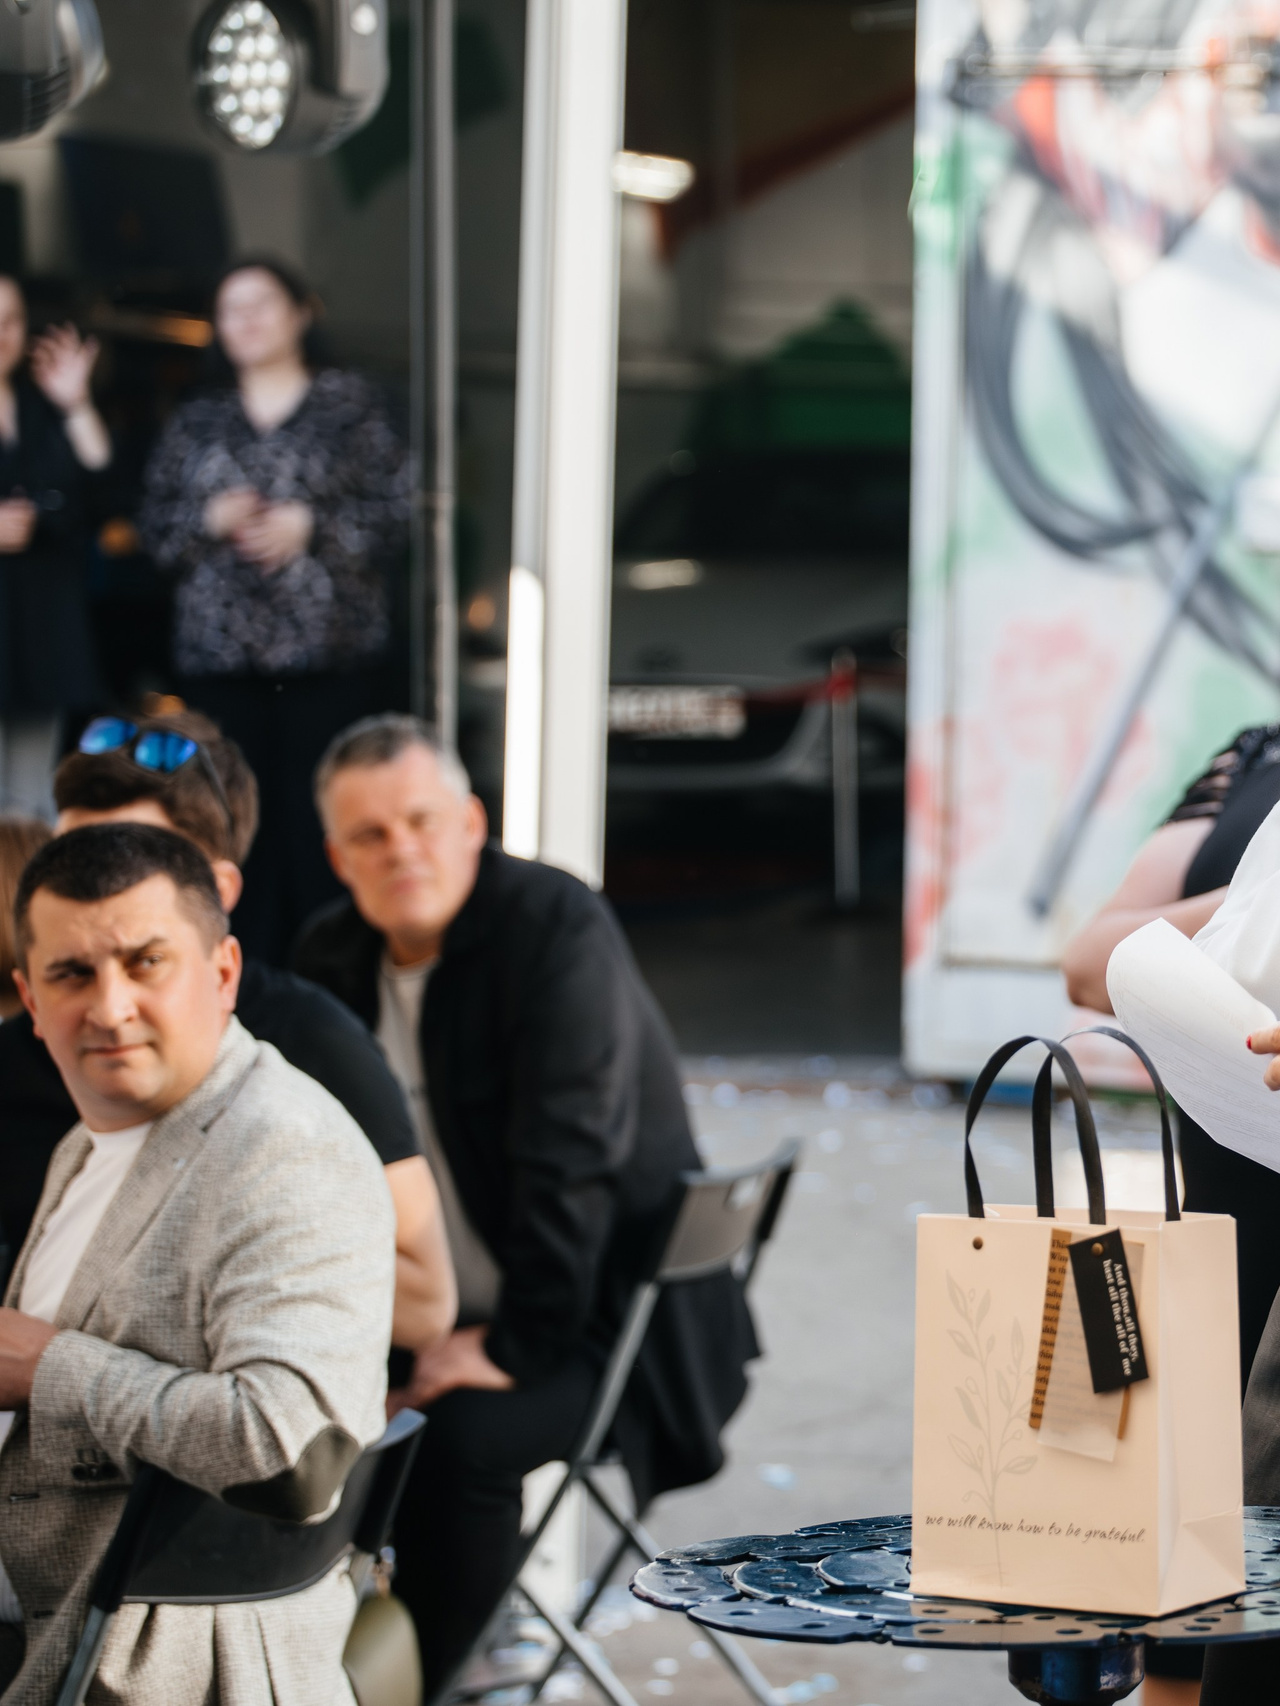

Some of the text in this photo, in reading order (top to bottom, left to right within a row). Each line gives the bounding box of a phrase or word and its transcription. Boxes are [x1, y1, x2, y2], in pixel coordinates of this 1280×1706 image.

[1113, 1262, 1127, 1287] And
[1108, 1285, 1120, 1302] all
[1111, 1302, 1122, 1322] the
[1115, 1322, 1127, 1340] all
[1119, 1340, 1130, 1354] of
[1122, 1357, 1132, 1377] me
[925, 1515, 943, 1526] we
[947, 1513, 977, 1528] will
[978, 1516, 1014, 1532] know
[1016, 1518, 1045, 1535] how
[1048, 1521, 1062, 1536] to
[1065, 1522, 1082, 1538] be
